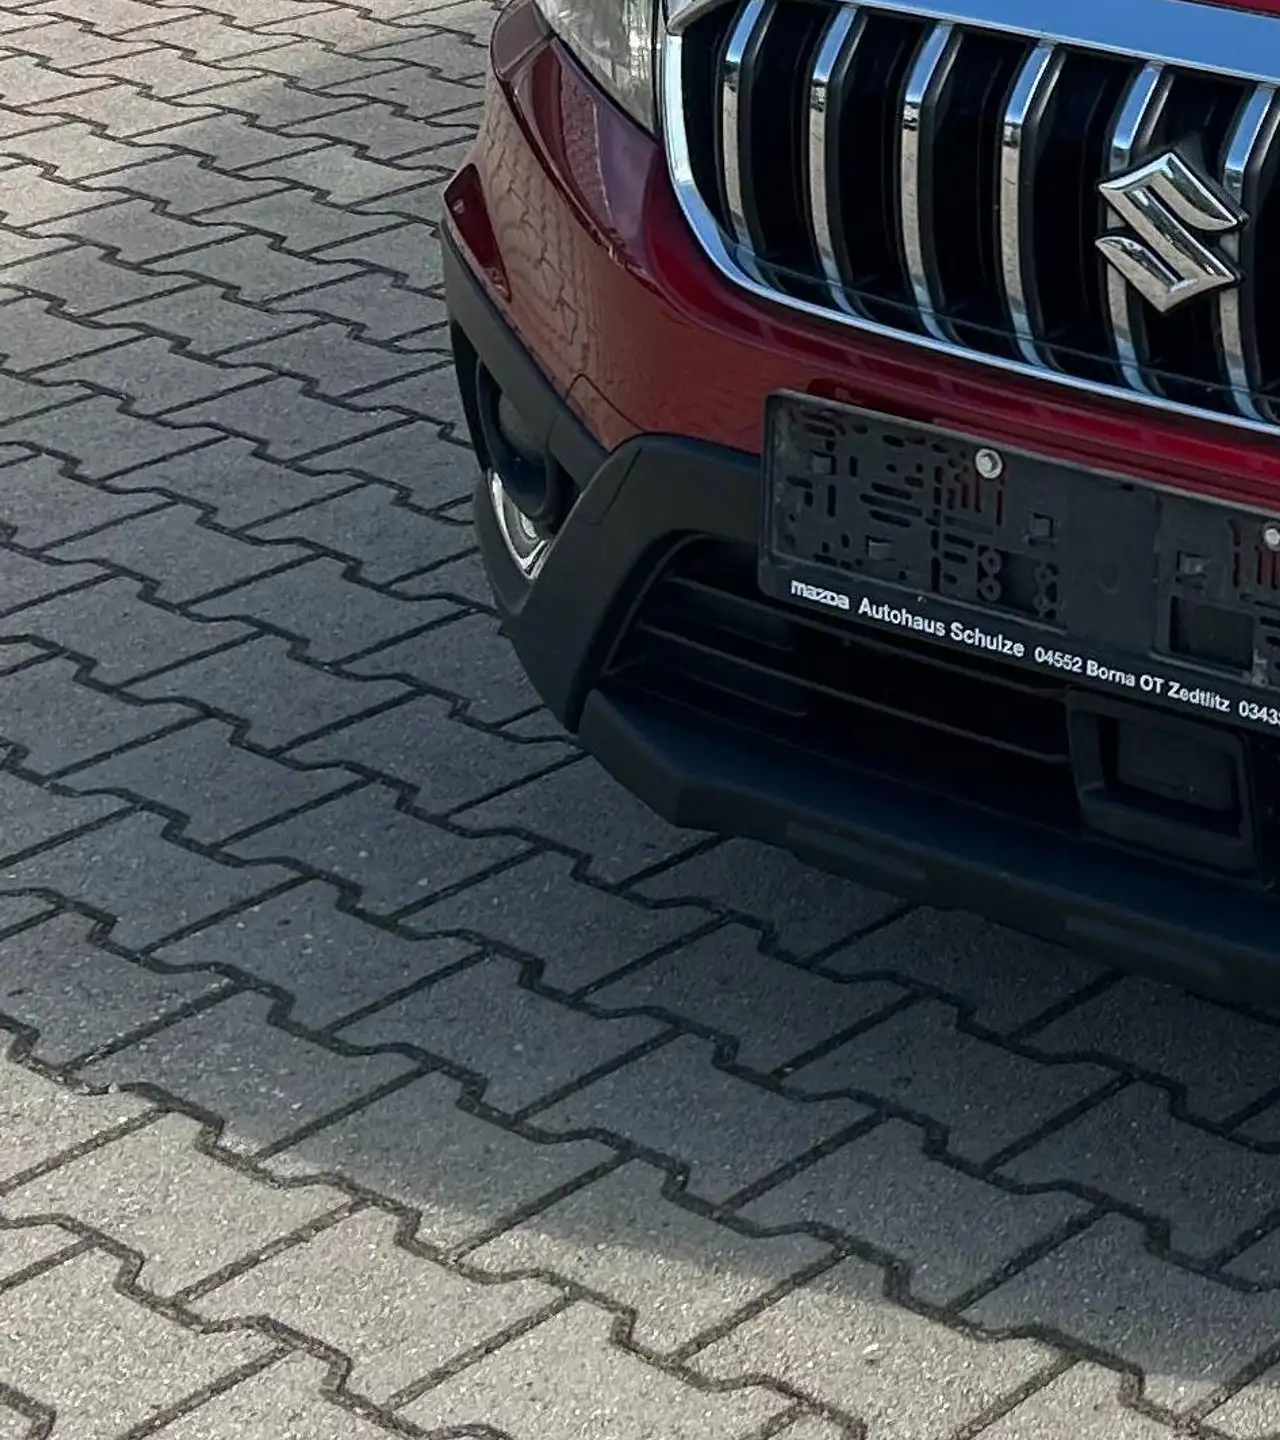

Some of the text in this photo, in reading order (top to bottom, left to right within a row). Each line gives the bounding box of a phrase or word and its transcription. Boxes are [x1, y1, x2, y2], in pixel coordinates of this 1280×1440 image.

[858, 597, 946, 637] Autohaus
[950, 621, 1026, 658] Schulze
[1034, 646, 1083, 674] 04552
[1086, 659, 1136, 688] Borna
[1139, 674, 1165, 694] OT
[1167, 680, 1231, 713] Zedtlitz
